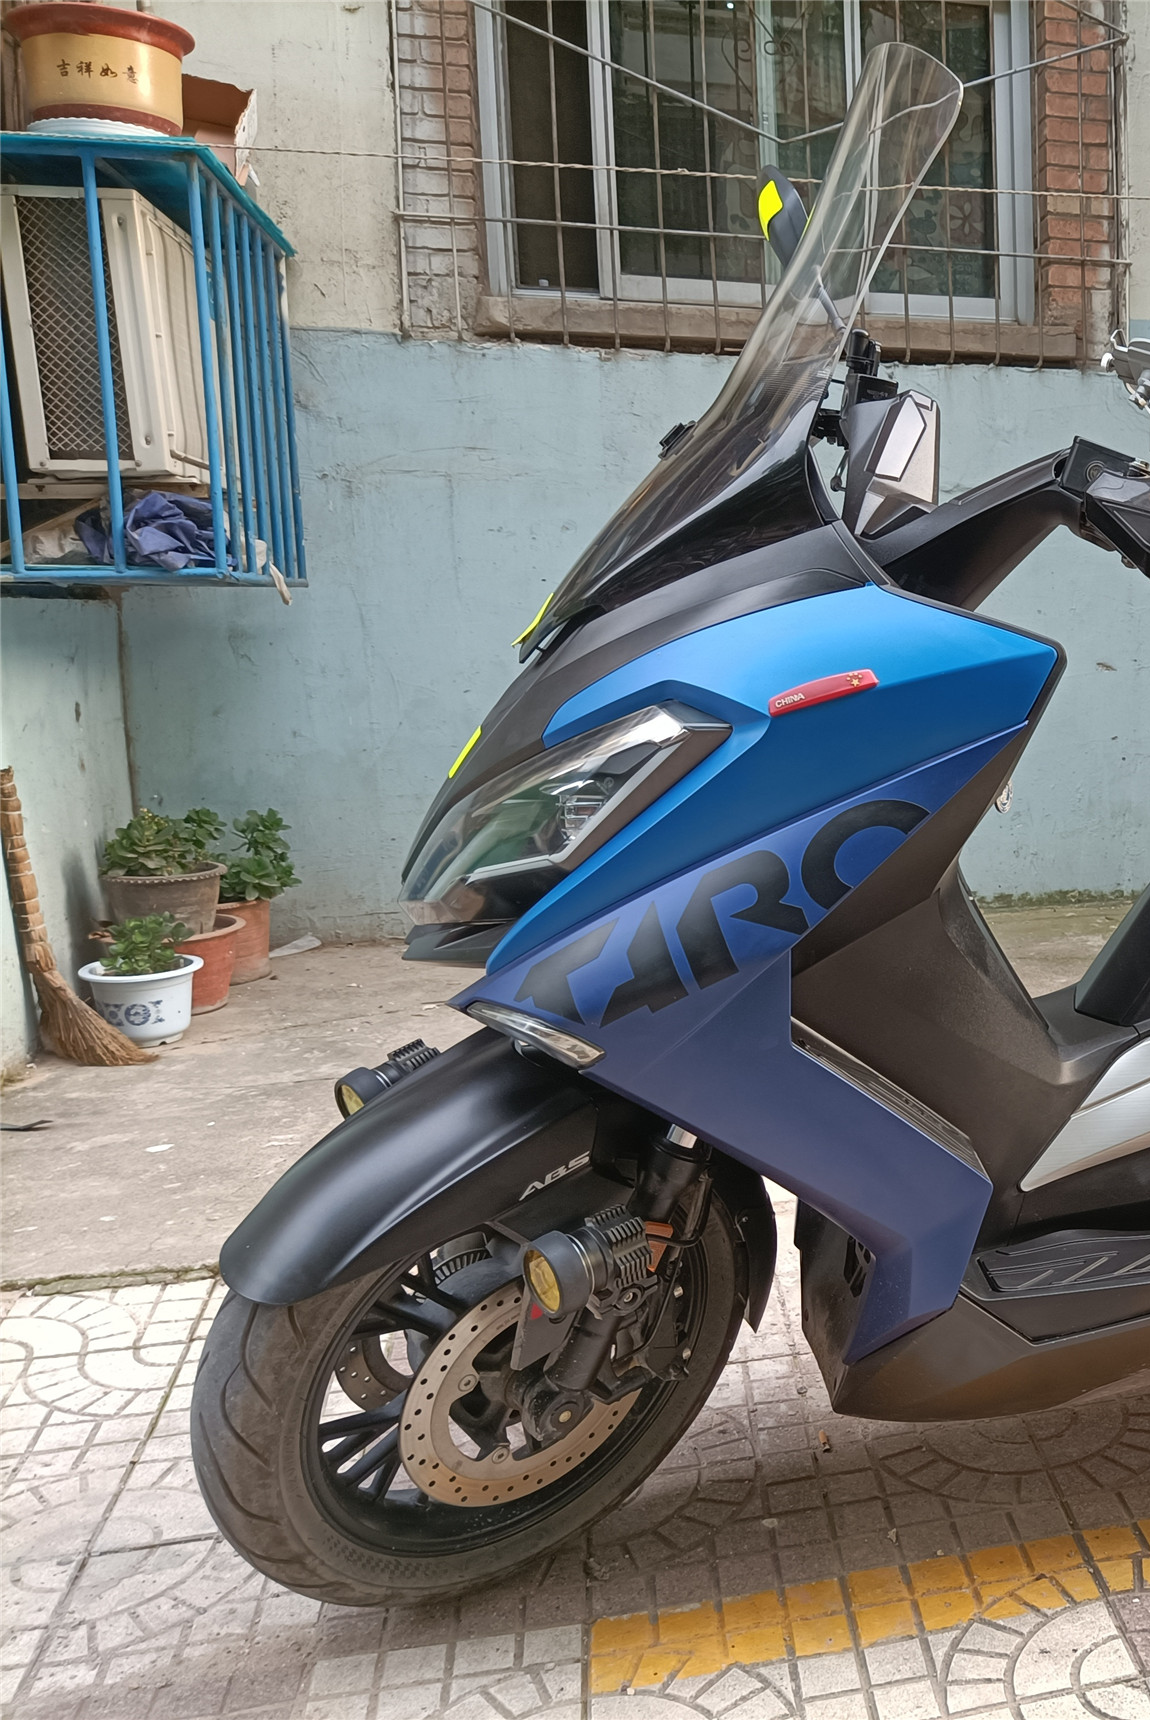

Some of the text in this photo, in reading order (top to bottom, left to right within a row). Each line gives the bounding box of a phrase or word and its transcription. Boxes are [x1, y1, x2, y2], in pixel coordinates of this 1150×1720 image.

[56, 59, 138, 84] 吉祥如意
[775, 693, 806, 708] CHINA
[513, 799, 932, 1029] TARO
[518, 1150, 591, 1201] ABS
